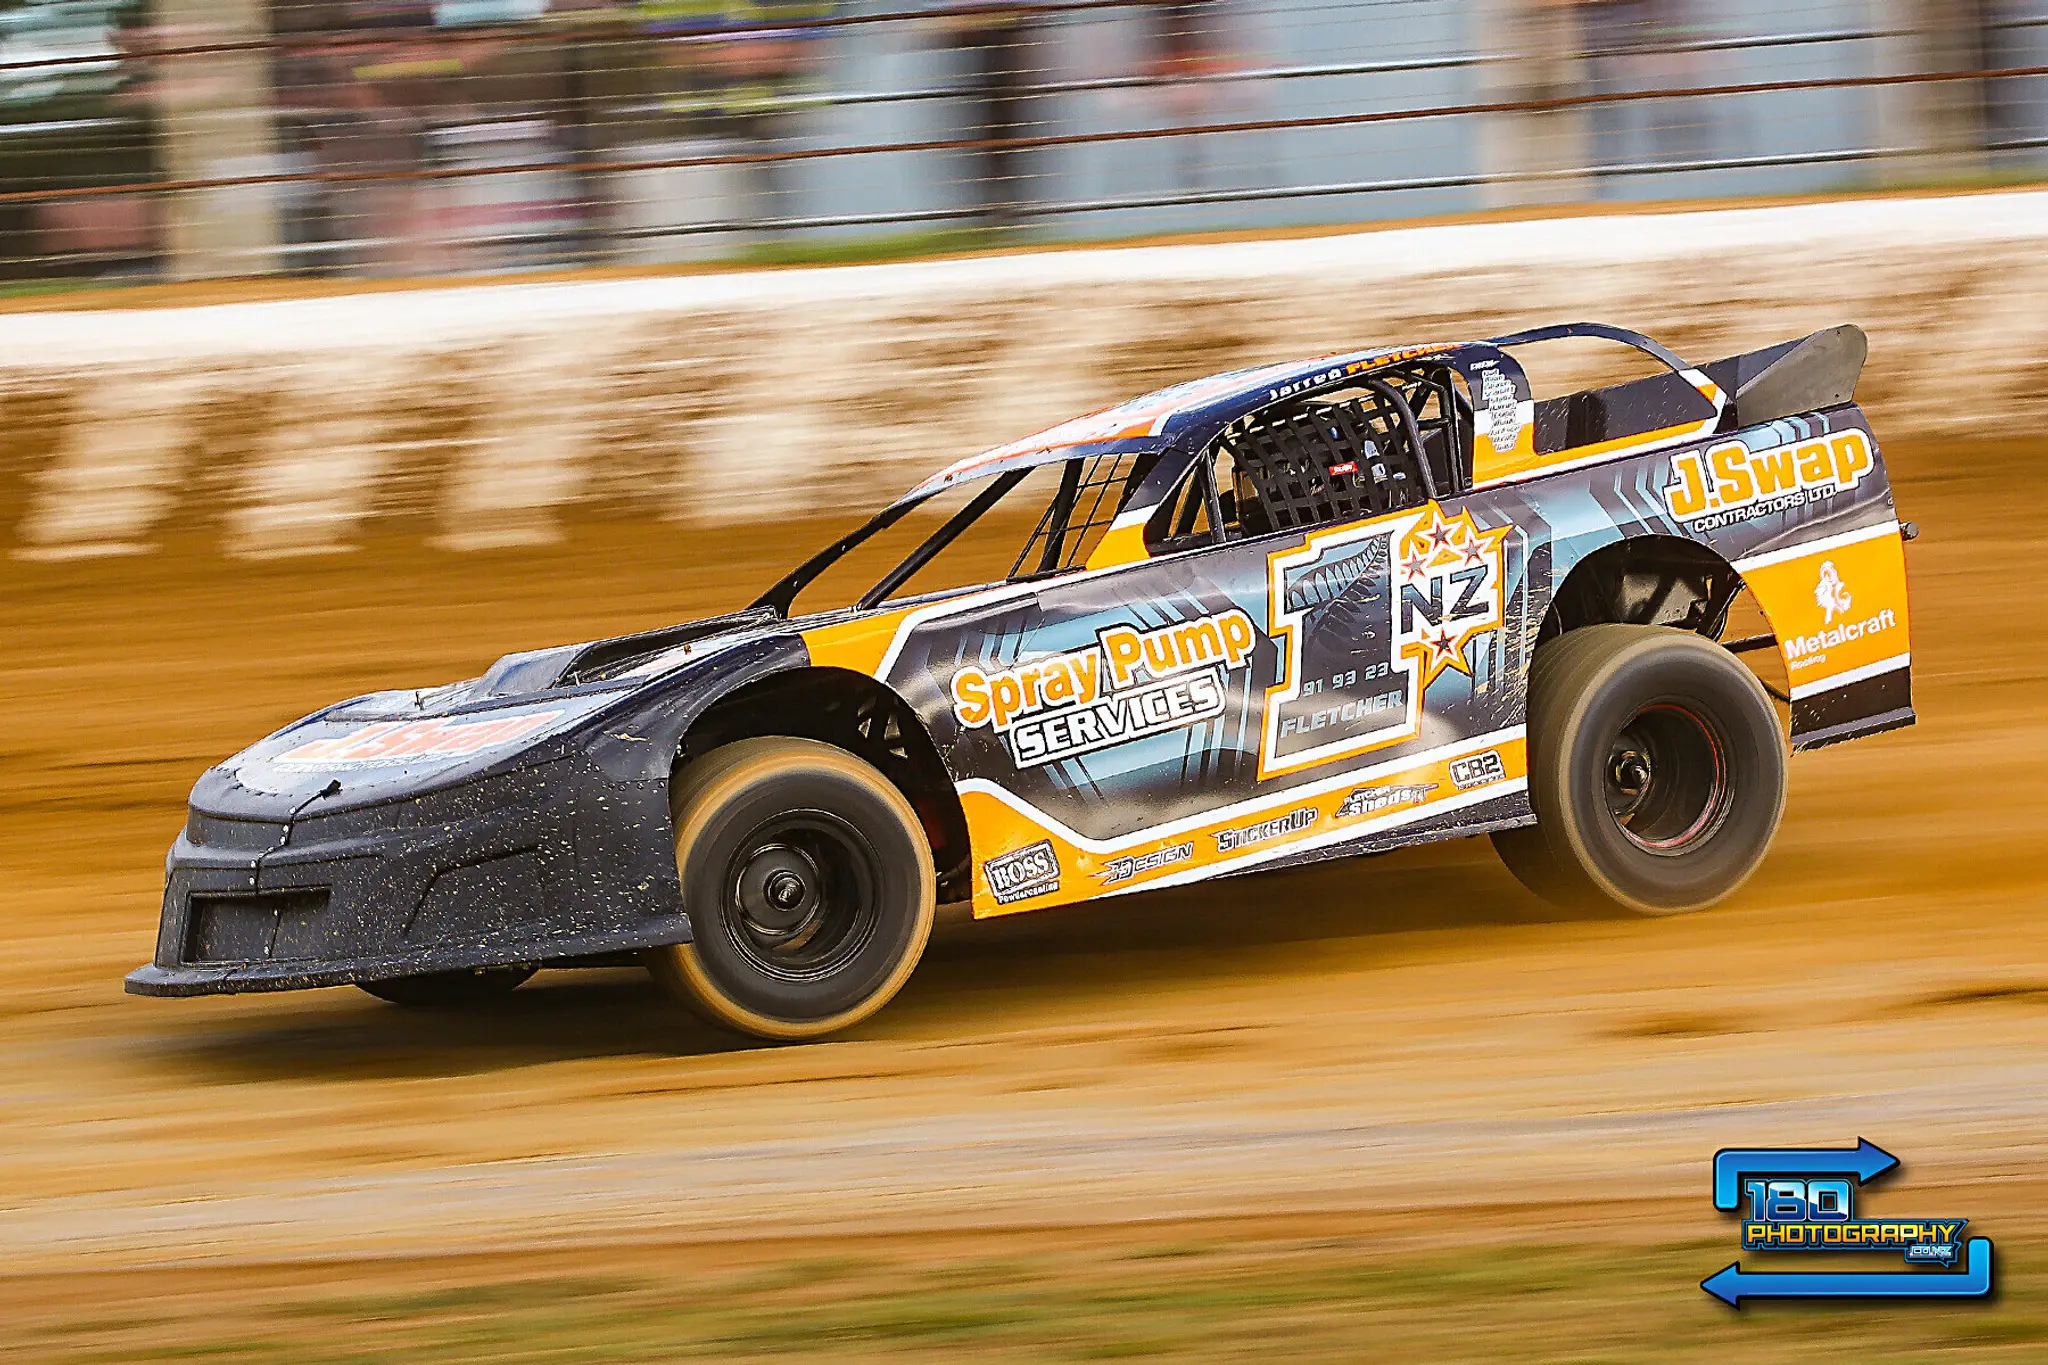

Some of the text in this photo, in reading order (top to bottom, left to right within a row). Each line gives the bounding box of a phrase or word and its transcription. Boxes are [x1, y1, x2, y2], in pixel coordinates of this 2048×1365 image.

[1667, 431, 1872, 518] J.Swap
[1694, 490, 1805, 533] CONTRACTORS
[1401, 564, 1489, 636] NZ
[1784, 608, 1896, 660] Metalcraft
[953, 611, 1253, 730] Spray Pump
[1303, 661, 1389, 697] 91 93 23
[1015, 672, 1216, 763] SERVICES
[1280, 689, 1404, 739] FLETCHER
[1452, 753, 1501, 783] CB2
